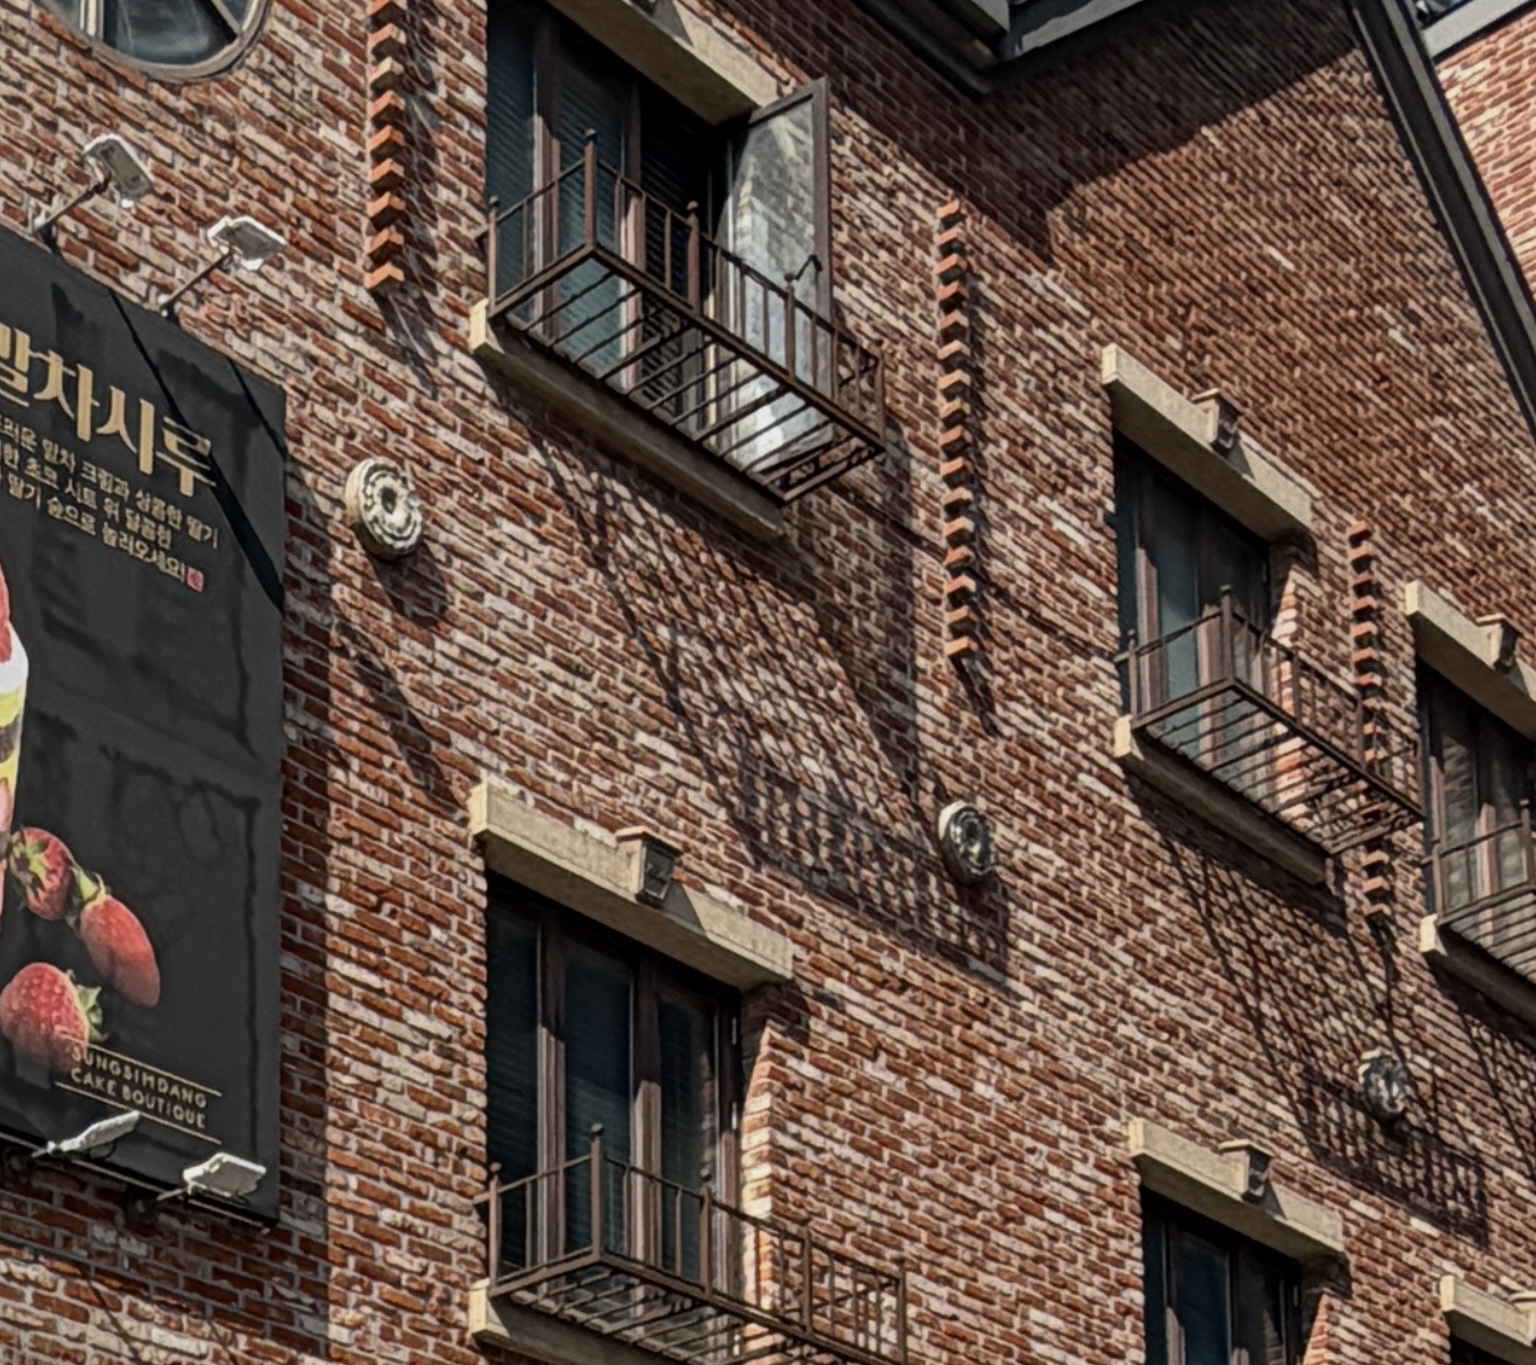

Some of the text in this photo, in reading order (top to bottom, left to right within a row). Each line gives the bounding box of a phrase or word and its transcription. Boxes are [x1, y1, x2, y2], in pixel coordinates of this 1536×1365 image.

[7, 474, 41, 511] 딸기
[24, 457, 59, 491] 초코
[42, 439, 76, 473] 말차
[186, 515, 219, 550] 딸기
[70, 1068, 207, 1128] CAKE BOUTIQUE
[71, 1046, 207, 1108] SUNGSIMDANG
